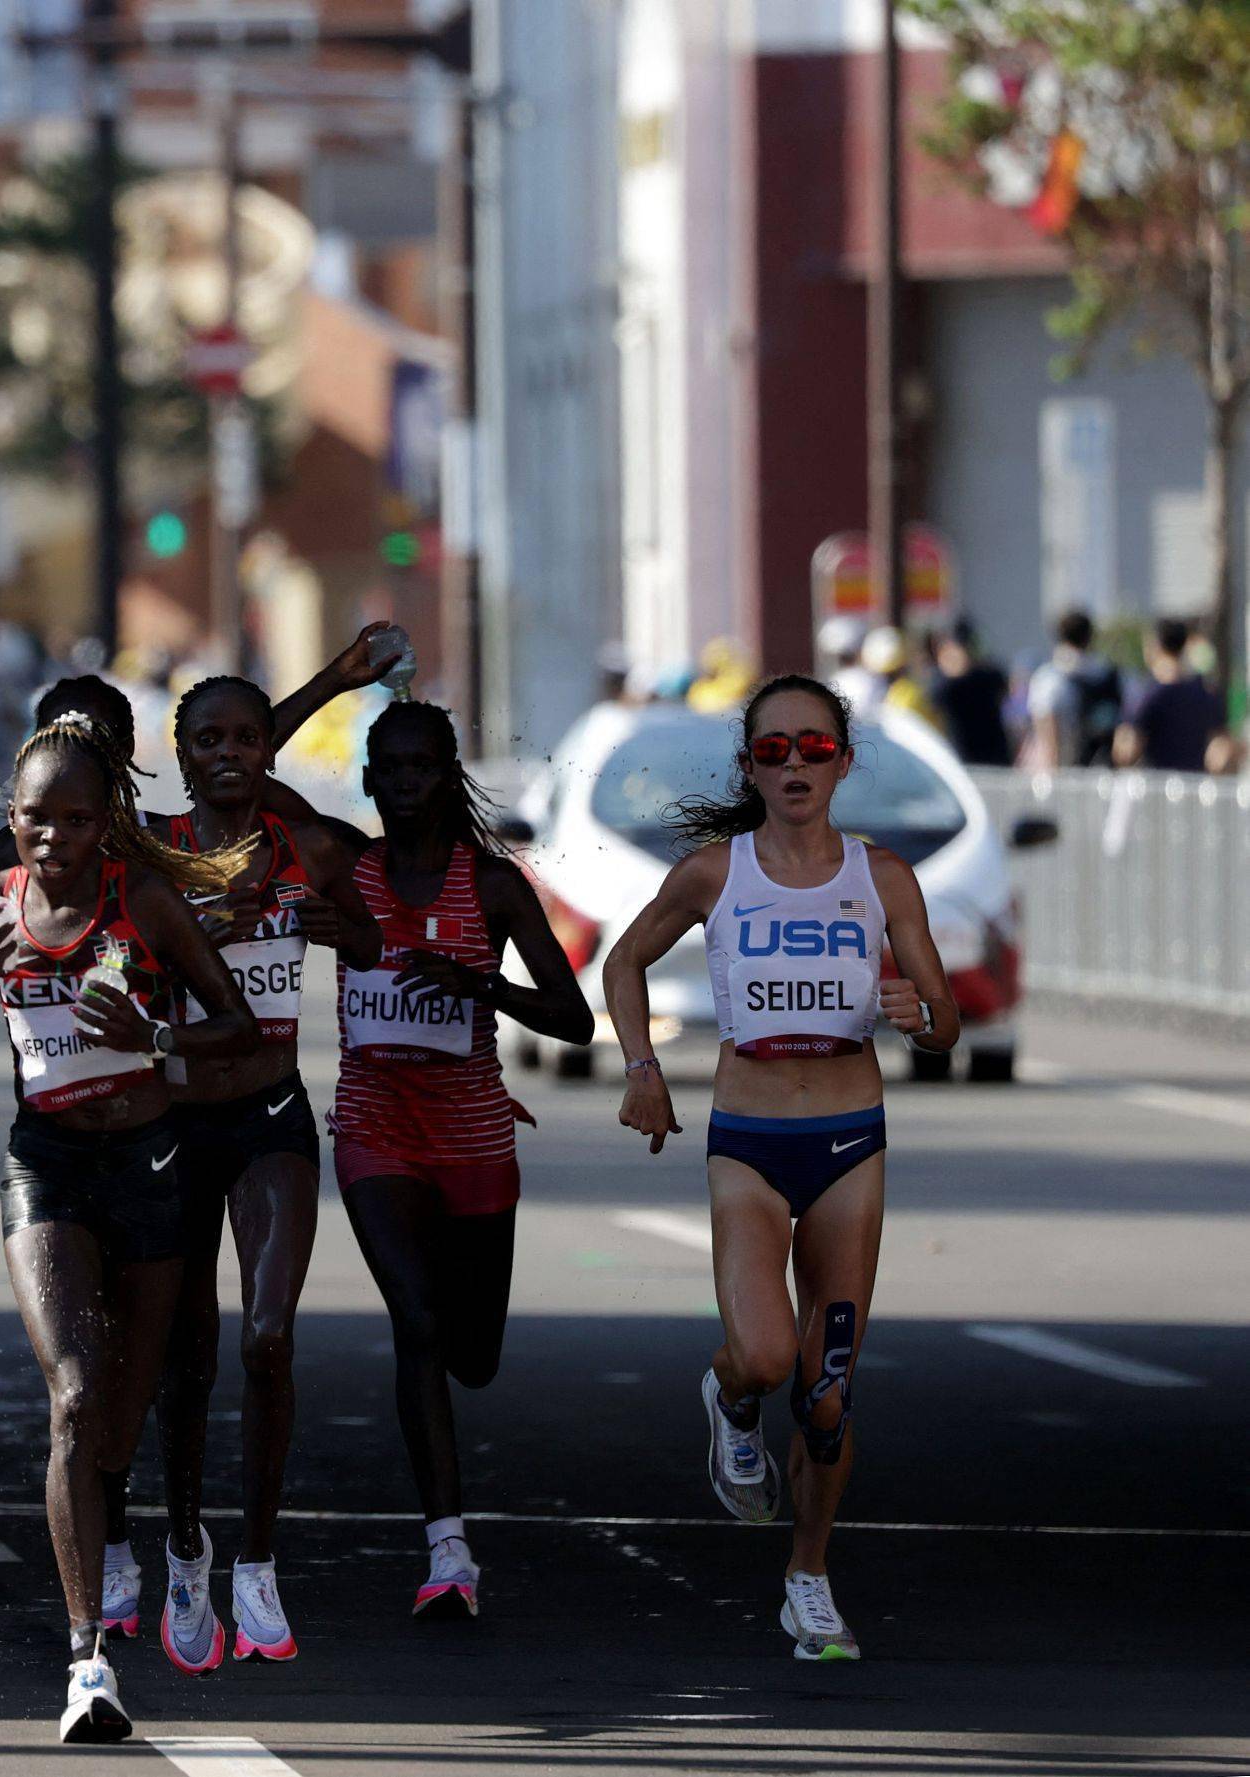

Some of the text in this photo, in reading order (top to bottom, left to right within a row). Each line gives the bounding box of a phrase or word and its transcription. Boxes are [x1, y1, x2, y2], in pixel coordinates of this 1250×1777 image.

[738, 919, 867, 959] USA
[347, 988, 466, 1026] CHUMBA
[746, 980, 854, 1012] SEIDEL
[22, 1035, 95, 1058] JEPCHIR
[770, 1042, 793, 1051] TOKYO
[51, 1093, 74, 1104] TOKYO
[834, 1314, 847, 1324] KT
